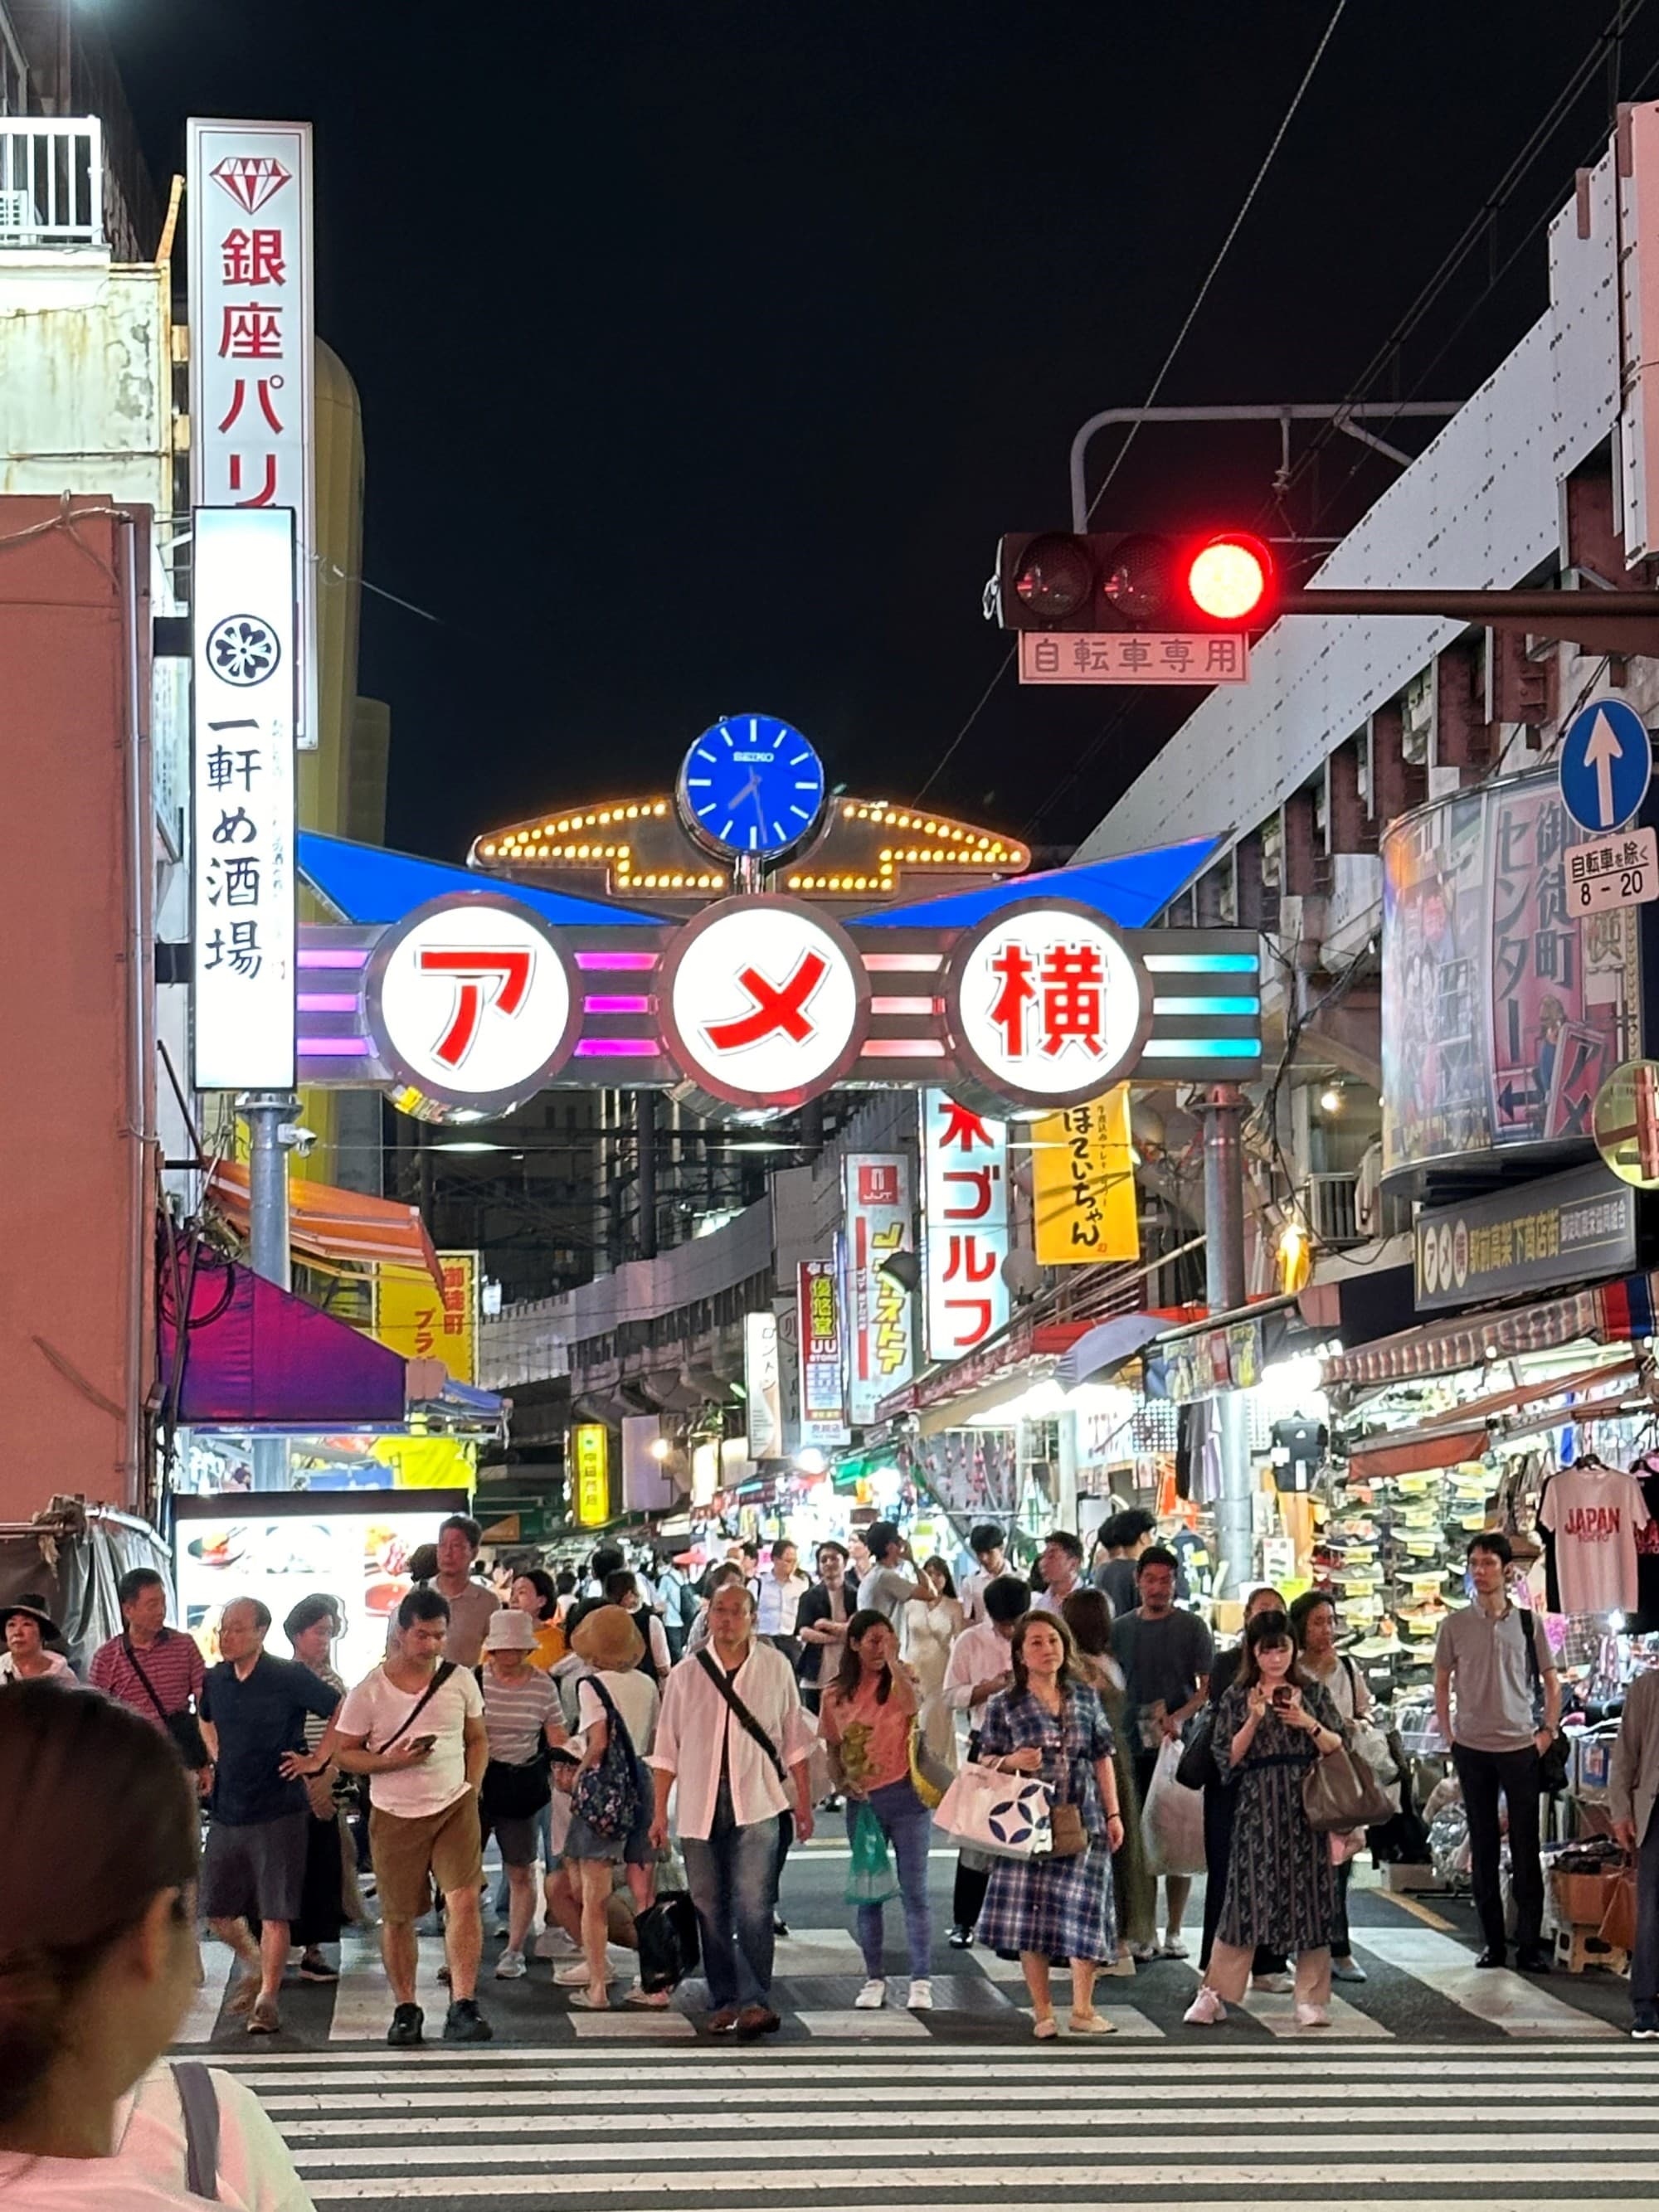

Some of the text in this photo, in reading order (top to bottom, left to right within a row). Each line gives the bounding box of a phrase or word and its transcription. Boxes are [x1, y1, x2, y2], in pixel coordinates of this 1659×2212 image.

[217, 228, 287, 508] 銀座パリ
[1034, 638, 1238, 673] 自転車専用
[733, 751, 774, 762] SEIKO
[205, 718, 264, 980] 一軒め酒場
[1571, 838, 1649, 880] 自転車を除く
[1494, 809, 1533, 1065] センター
[1063, 1106, 1103, 1247] ほていちゃん
[444, 1266, 465, 1335] 御徒町
[415, 1308, 436, 1359] プラ
[1564, 1506, 1620, 1535] JAPAN
